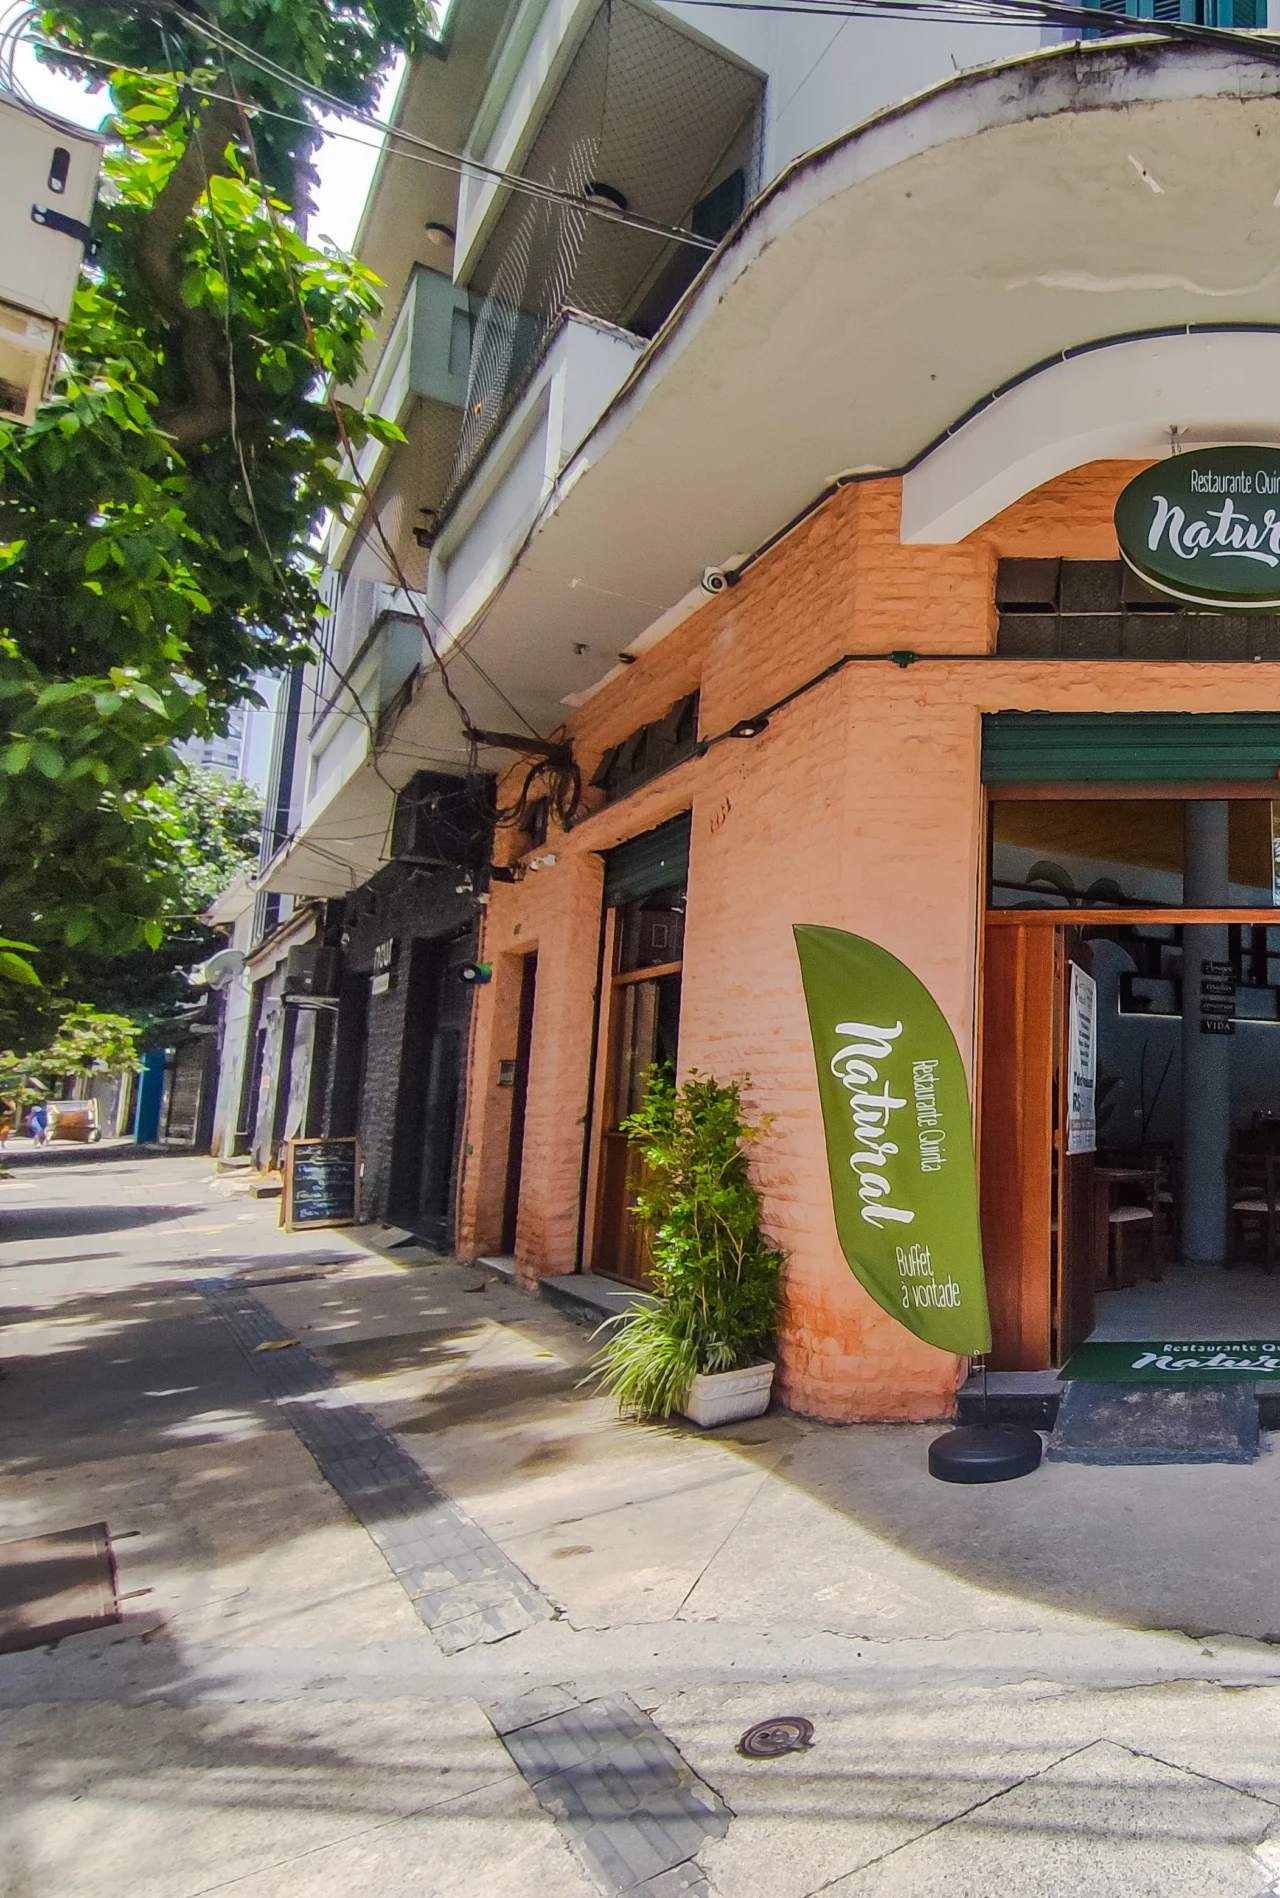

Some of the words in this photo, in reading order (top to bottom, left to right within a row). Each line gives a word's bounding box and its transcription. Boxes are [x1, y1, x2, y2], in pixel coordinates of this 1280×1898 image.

[1190, 469, 1252, 494] Restaurante
[1206, 1021, 1231, 1030] VIDA
[911, 1058, 939, 1128] Restaurante
[830, 1020, 914, 1230] Natural
[919, 1129, 946, 1172] Quinta
[895, 1243, 934, 1278] Buffet
[902, 1281, 910, 1309] à
[914, 1276, 961, 1308] vontade
[1163, 1343, 1258, 1353] Restaurante
